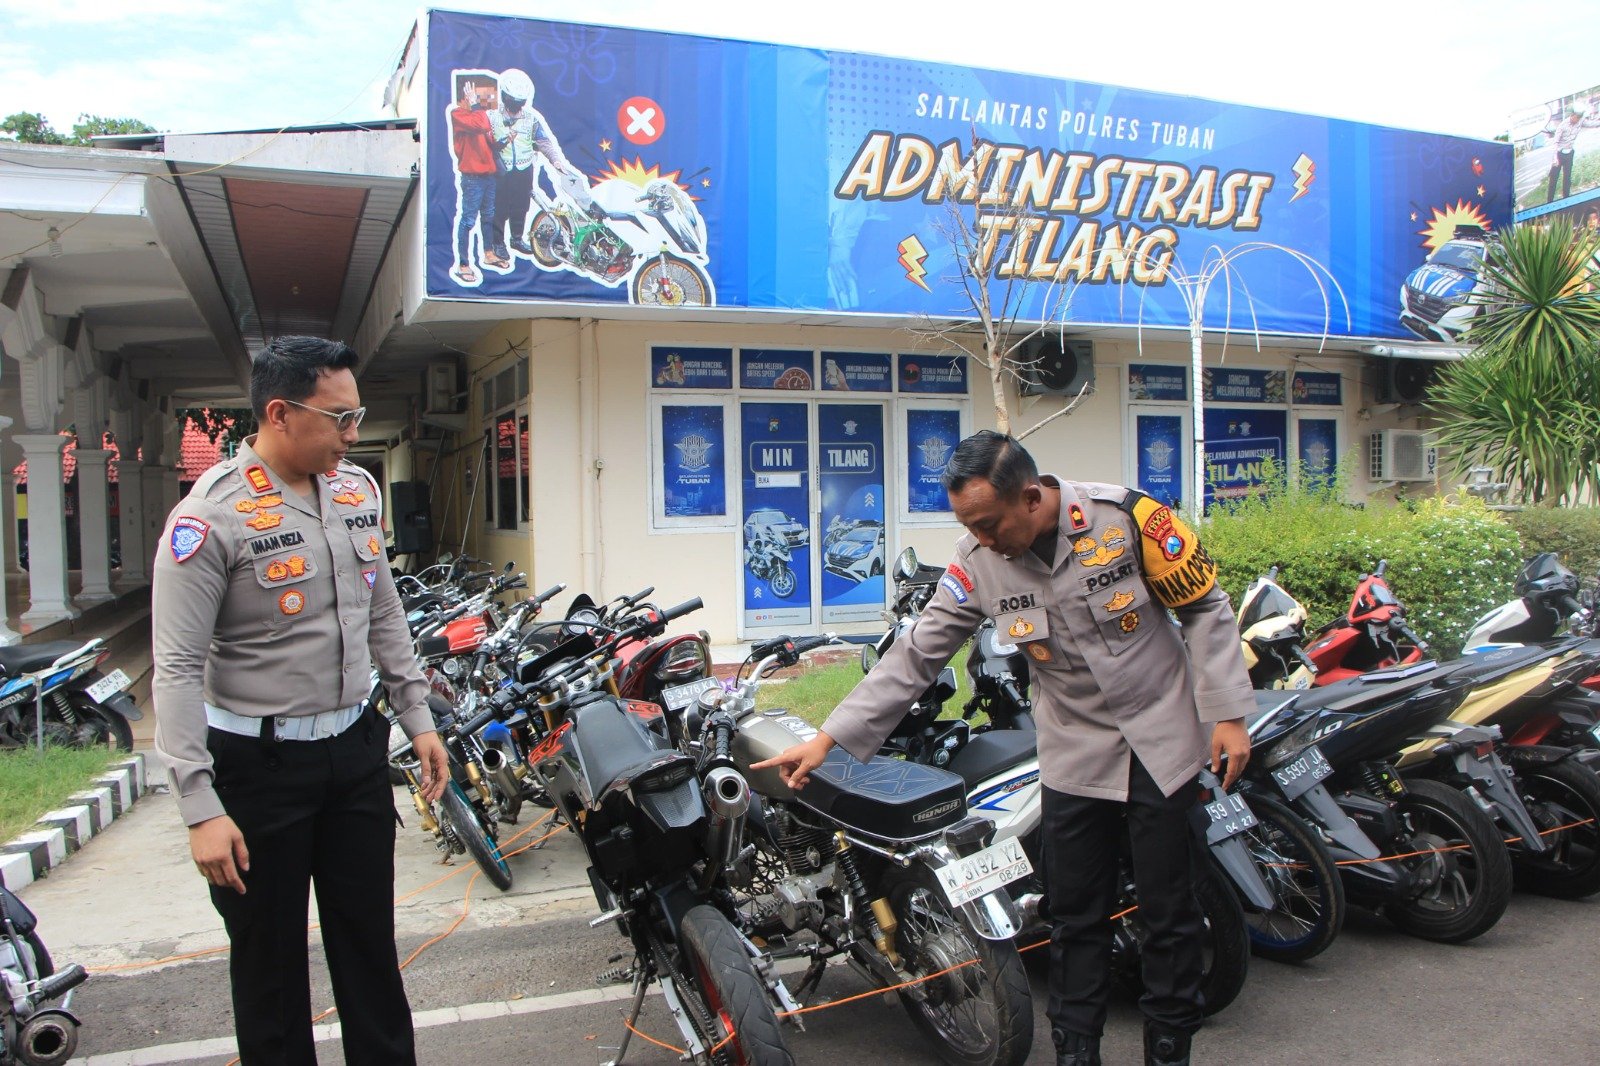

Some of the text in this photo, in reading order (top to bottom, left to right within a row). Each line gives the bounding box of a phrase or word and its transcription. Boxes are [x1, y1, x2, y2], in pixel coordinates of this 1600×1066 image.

[915, 93, 1216, 151] SATLANTAS POLRES TUBAN
[835, 130, 1276, 232] ADMINISTRASI
[974, 213, 1180, 286] TILANG
[1228, 375, 1250, 385] JANGAN
[1216, 386, 1261, 397] MELAWAN ARUS
[762, 448, 793, 467] MIN
[828, 449, 869, 467] TILANG
[1237, 448, 1275, 459] ADMINISTRASI
[251, 531, 305, 555] IMAM REZA
[1087, 562, 1134, 592] POLRI
[999, 594, 1036, 613] ROBI
[1285, 757, 1311, 781] 5937
[1309, 749, 1326, 766] JA
[917, 799, 959, 821] HONDA
[1229, 795, 1245, 813] LV
[961, 852, 999, 881] 3192
[1000, 842, 1022, 863] YZ
